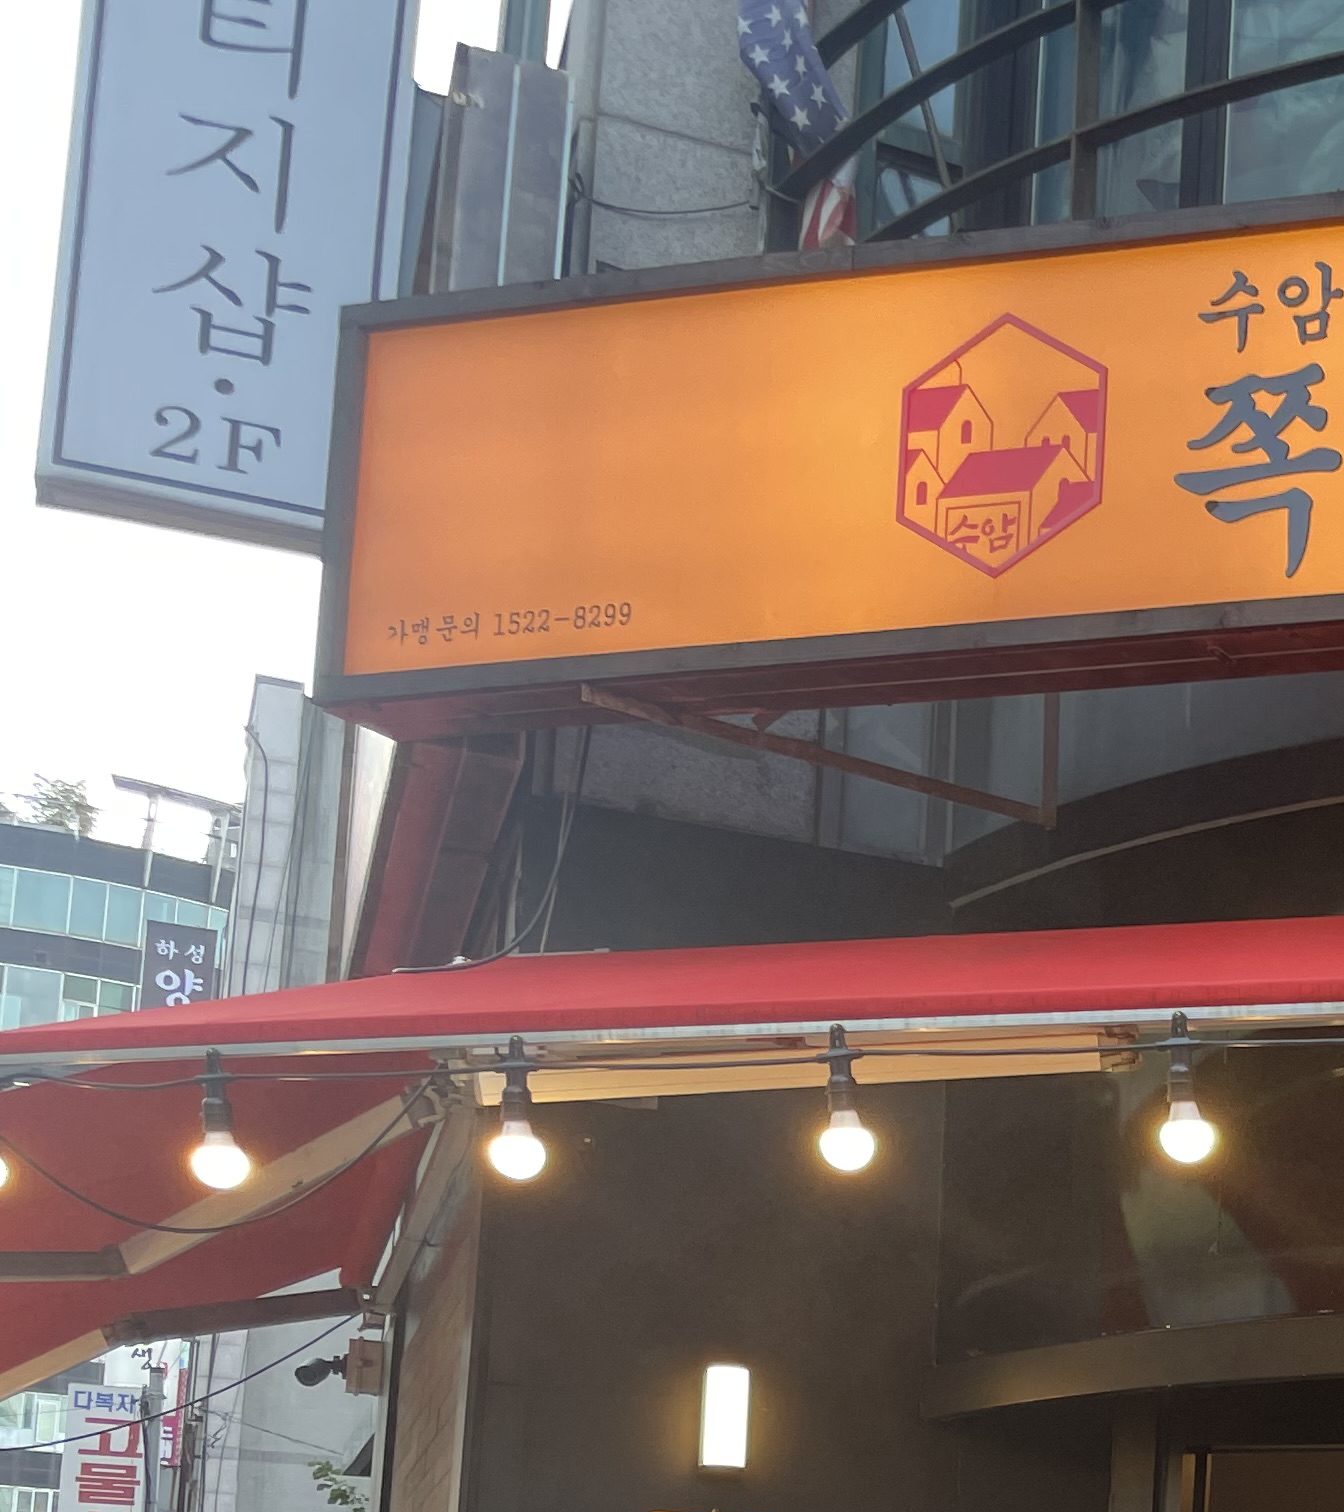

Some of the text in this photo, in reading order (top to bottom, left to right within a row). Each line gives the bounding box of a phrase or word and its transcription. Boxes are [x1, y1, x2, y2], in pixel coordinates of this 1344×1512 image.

[150, 405, 281, 474] 2F
[948, 513, 1017, 554] 수암
[388, 602, 633, 648] 가맹문의 1522-8299
[155, 939, 206, 965] 하성
